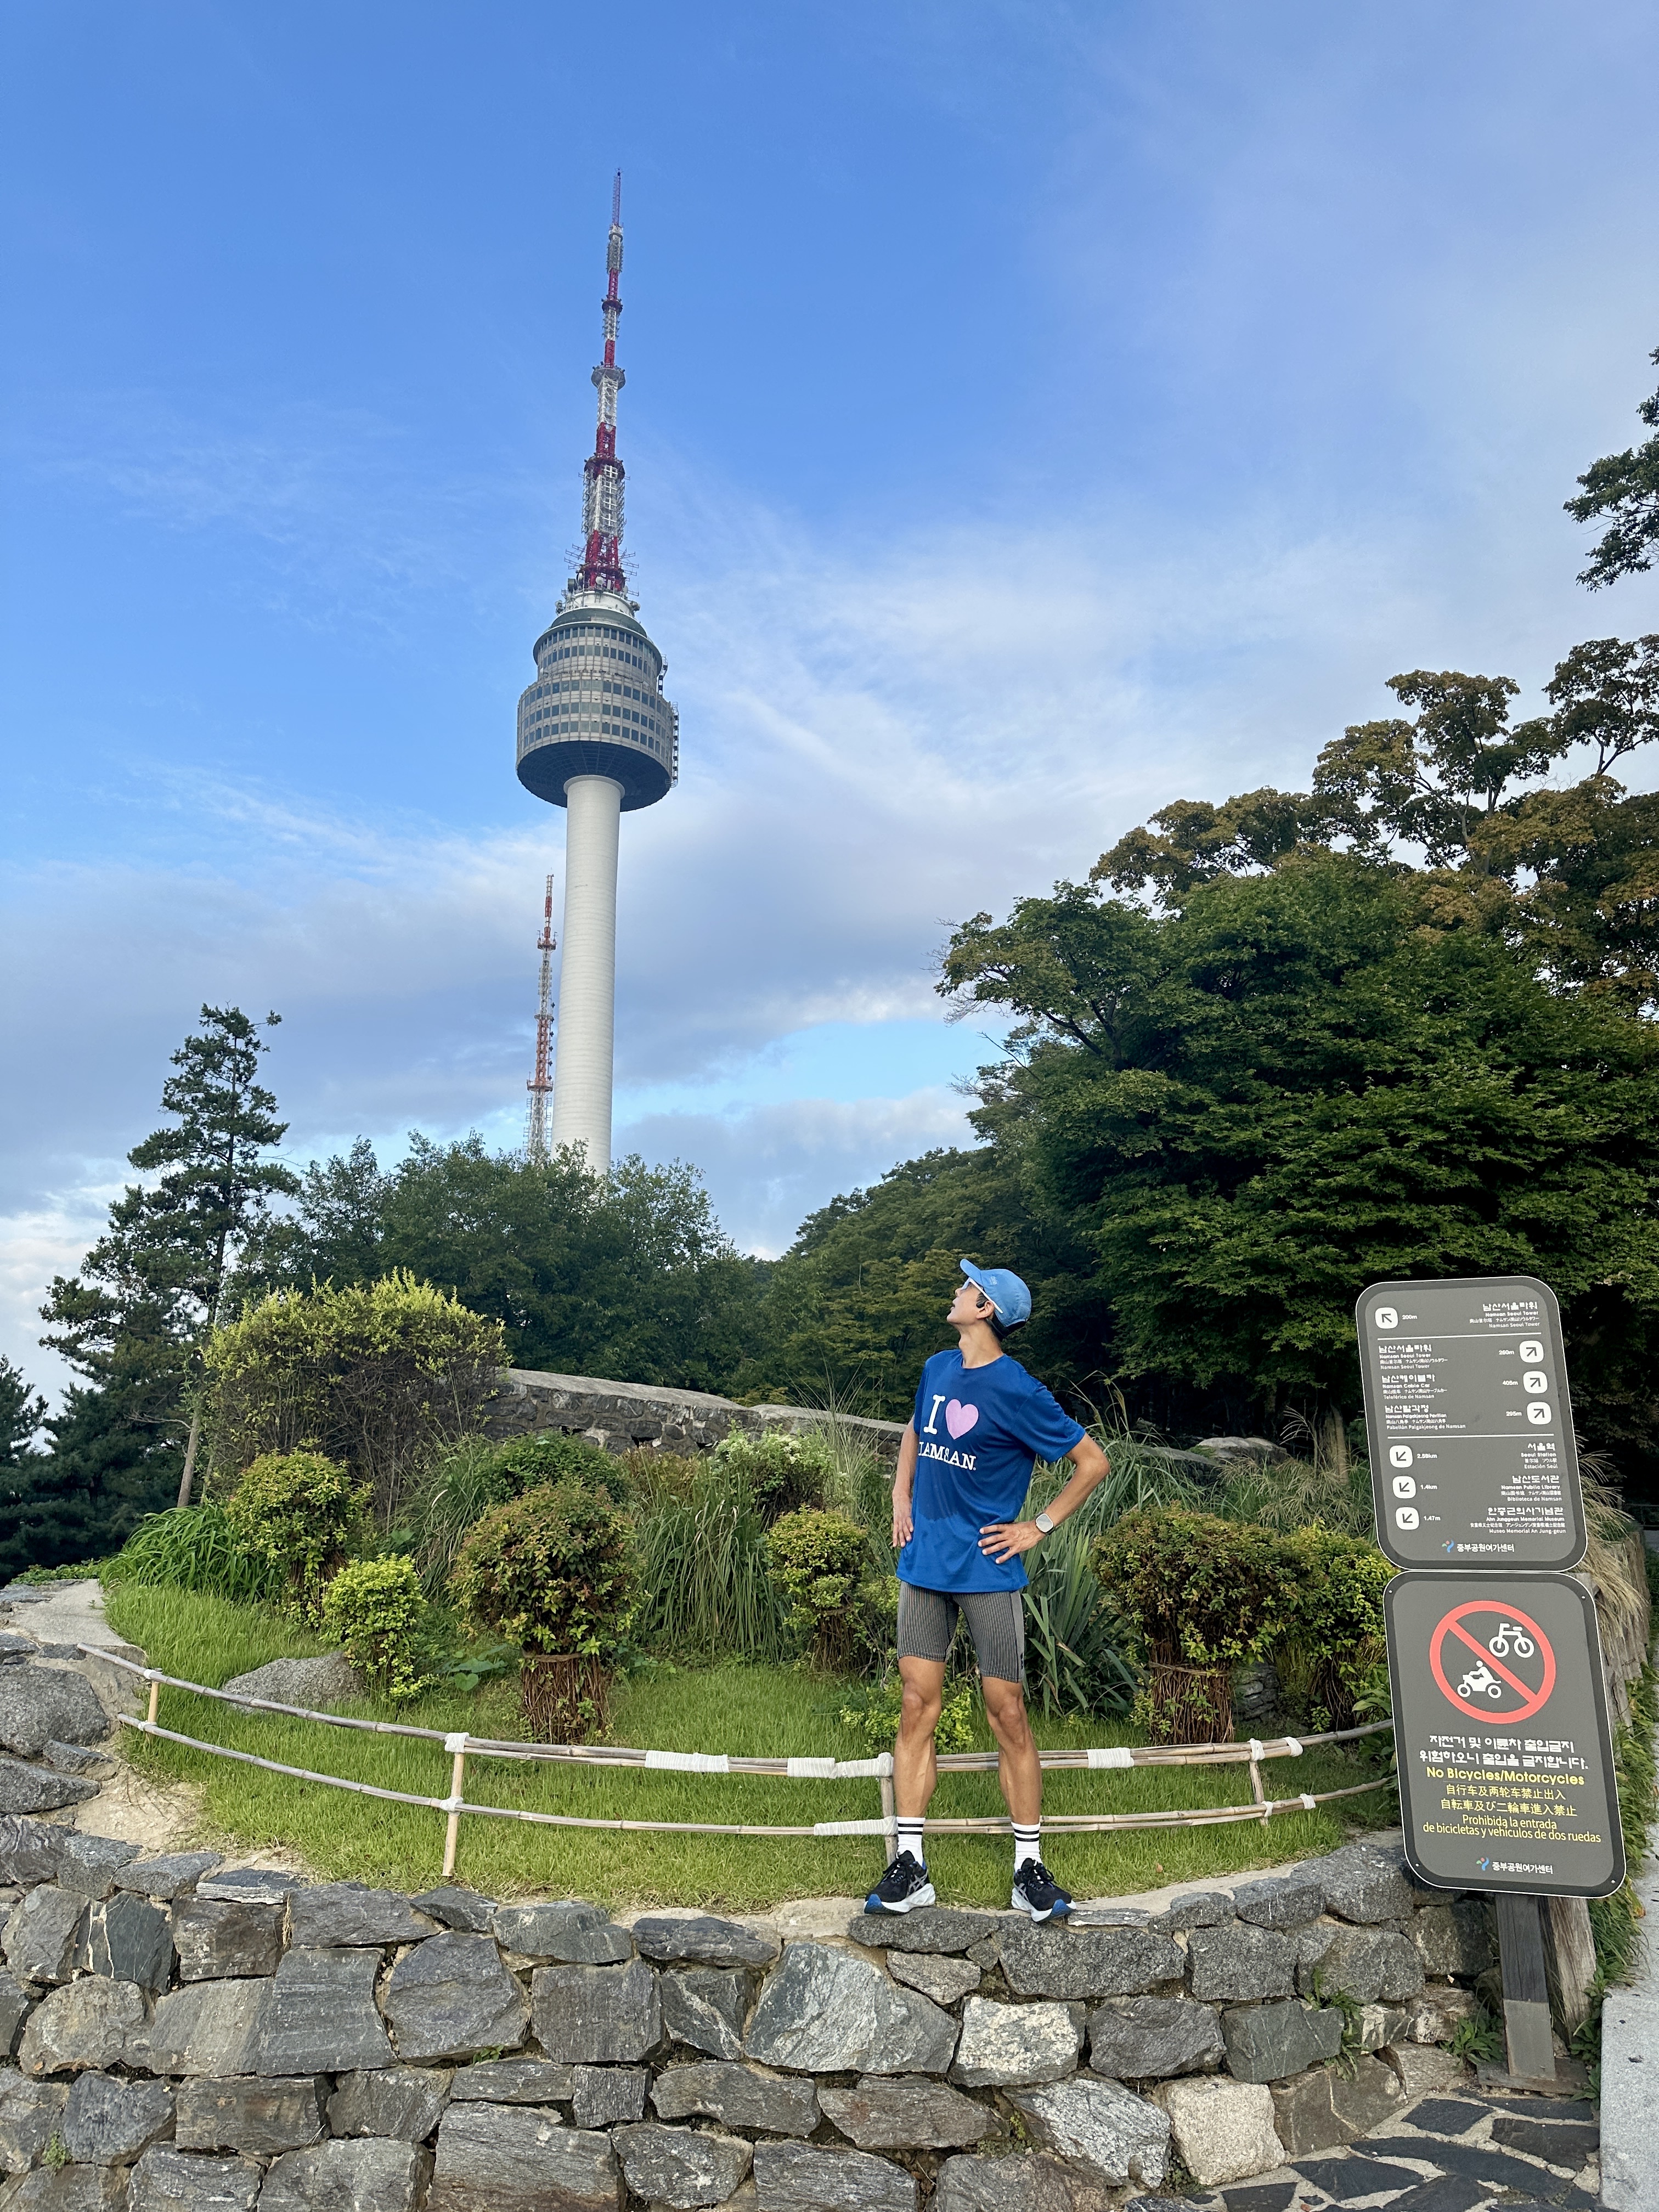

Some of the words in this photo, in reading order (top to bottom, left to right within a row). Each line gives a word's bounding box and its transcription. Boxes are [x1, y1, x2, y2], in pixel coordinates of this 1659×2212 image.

[1483, 1302, 1537, 1311] 남산서울타워
[1379, 1344, 1432, 1353] 남산서울타워
[1382, 1374, 1435, 1383] 남산케이블카
[923, 1394, 946, 1435] I
[1385, 1404, 1429, 1413] 남산팔각정
[1527, 1442, 1555, 1451] 서울역
[1512, 1475, 1559, 1483] 남산도서관
[1488, 1507, 1564, 1516] 안중근의사기념관
[1457, 1543, 1515, 1553] 중부공원여가센터
[1429, 1735, 1466, 1748] 자전거
[1469, 1736, 1481, 1749] 및
[1485, 1737, 1521, 1751] 이륜차
[1524, 1739, 1575, 1753] 출입금지
[1419, 1750, 1480, 1765] 위험하오니
[1482, 1753, 1520, 1767] 출입을
[1522, 1754, 1589, 1770] 금지합니다.
[1426, 1766, 1444, 1778] No
[1447, 1767, 1585, 1786] Bicycles/Motorcycles
[1446, 1784, 1566, 1801] 自行车及两轮车禁止出入
[1441, 1798, 1578, 1817] 自転車及び二輪車進入禁止
[1463, 1814, 1508, 1827] Prohibida
[1509, 1816, 1518, 1827] la
[1520, 1818, 1557, 1830] entrada
[1423, 1822, 1435, 1833] de
[1436, 1822, 1480, 1836] bicicletas
[1481, 1827, 1487, 1838] y
[1534, 1829, 1547, 1839] de
[1548, 1830, 1566, 1841] dos
[1568, 1831, 1601, 1843] ruedas
[1492, 1861, 1553, 1874] 중부공원여가센터
